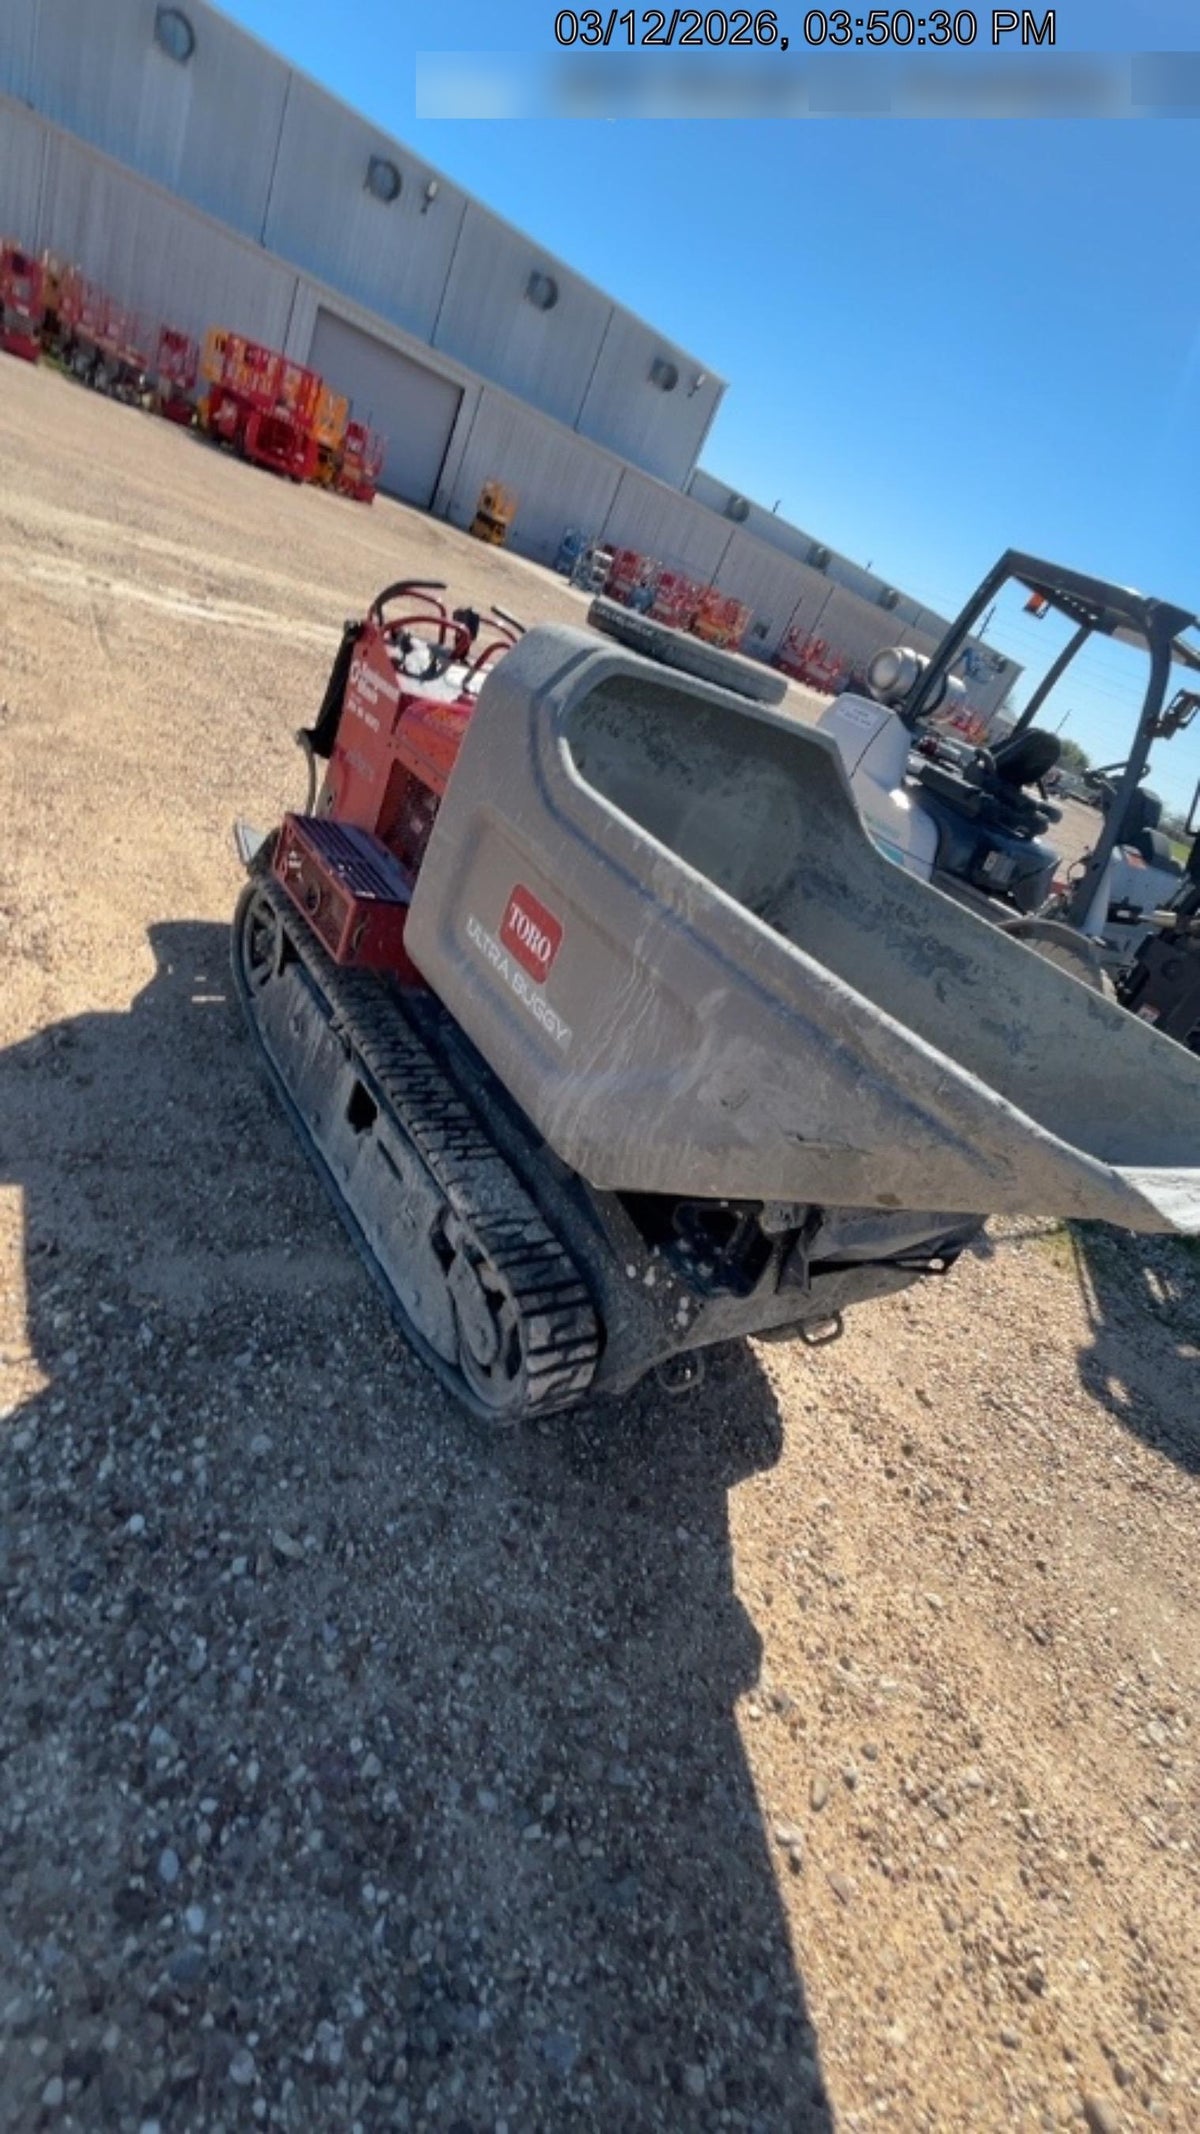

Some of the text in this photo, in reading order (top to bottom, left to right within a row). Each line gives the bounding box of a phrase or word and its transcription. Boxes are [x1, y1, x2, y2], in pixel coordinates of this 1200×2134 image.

[508, 902, 552, 962] TORO
[466, 916, 569, 1041] ULTRA BUGGY
